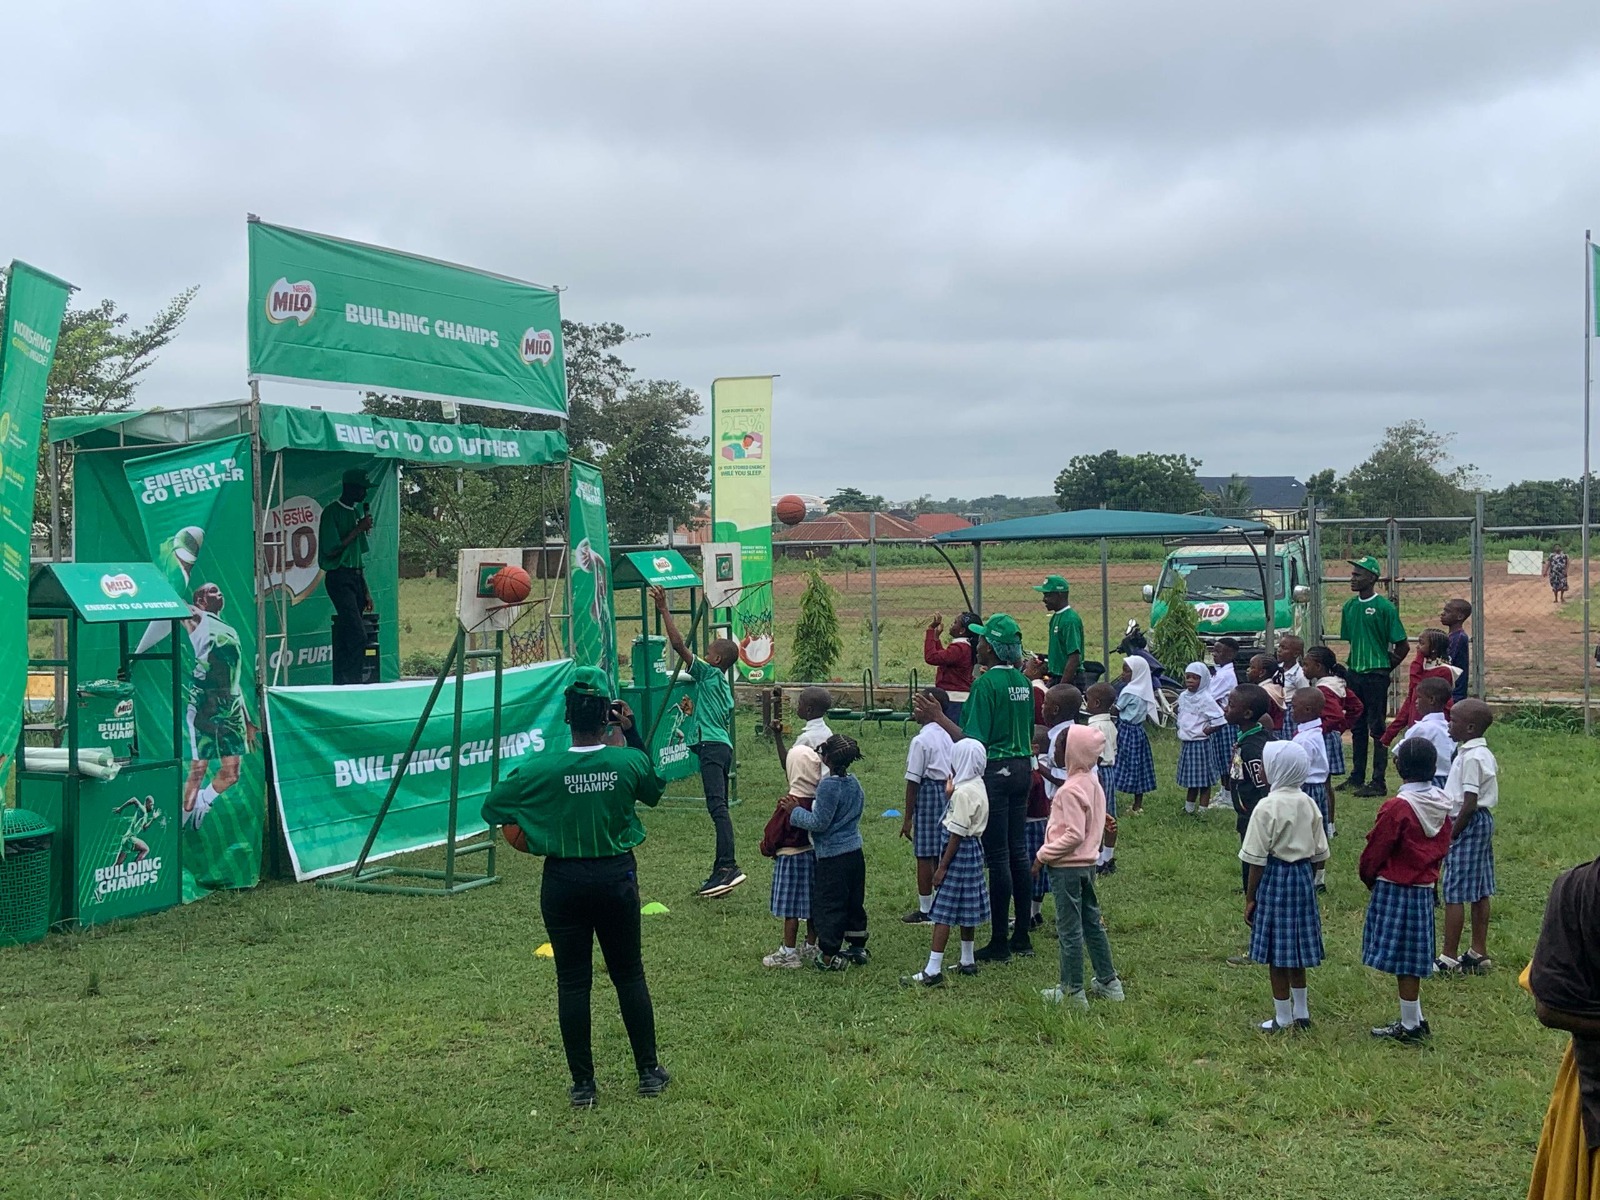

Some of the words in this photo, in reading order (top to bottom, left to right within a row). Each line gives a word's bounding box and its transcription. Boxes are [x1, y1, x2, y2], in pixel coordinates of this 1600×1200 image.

[273, 292, 312, 312] MILO
[345, 303, 430, 335] BUILDING
[434, 320, 498, 348] CHAMPS
[525, 338, 552, 354] MILO
[335, 424, 399, 450] ENEGY
[404, 432, 424, 452] TO
[429, 435, 454, 454] GO
[142, 488, 168, 504] GO
[173, 468, 244, 498] FURTER
[144, 462, 216, 490] ENERGY
[254, 526, 317, 575] ILO
[105, 580, 133, 592] MILO
[102, 730, 134, 739] CHAM
[458, 728, 545, 766] CHAMPS
[660, 742, 690, 757] BUILDIN
[662, 750, 689, 764] CHAMPS
[564, 771, 618, 784] BUILDING
[568, 781, 614, 794] CHAMPS
[95, 857, 161, 882] BUILDING
[98, 870, 158, 894] CHAMPS
